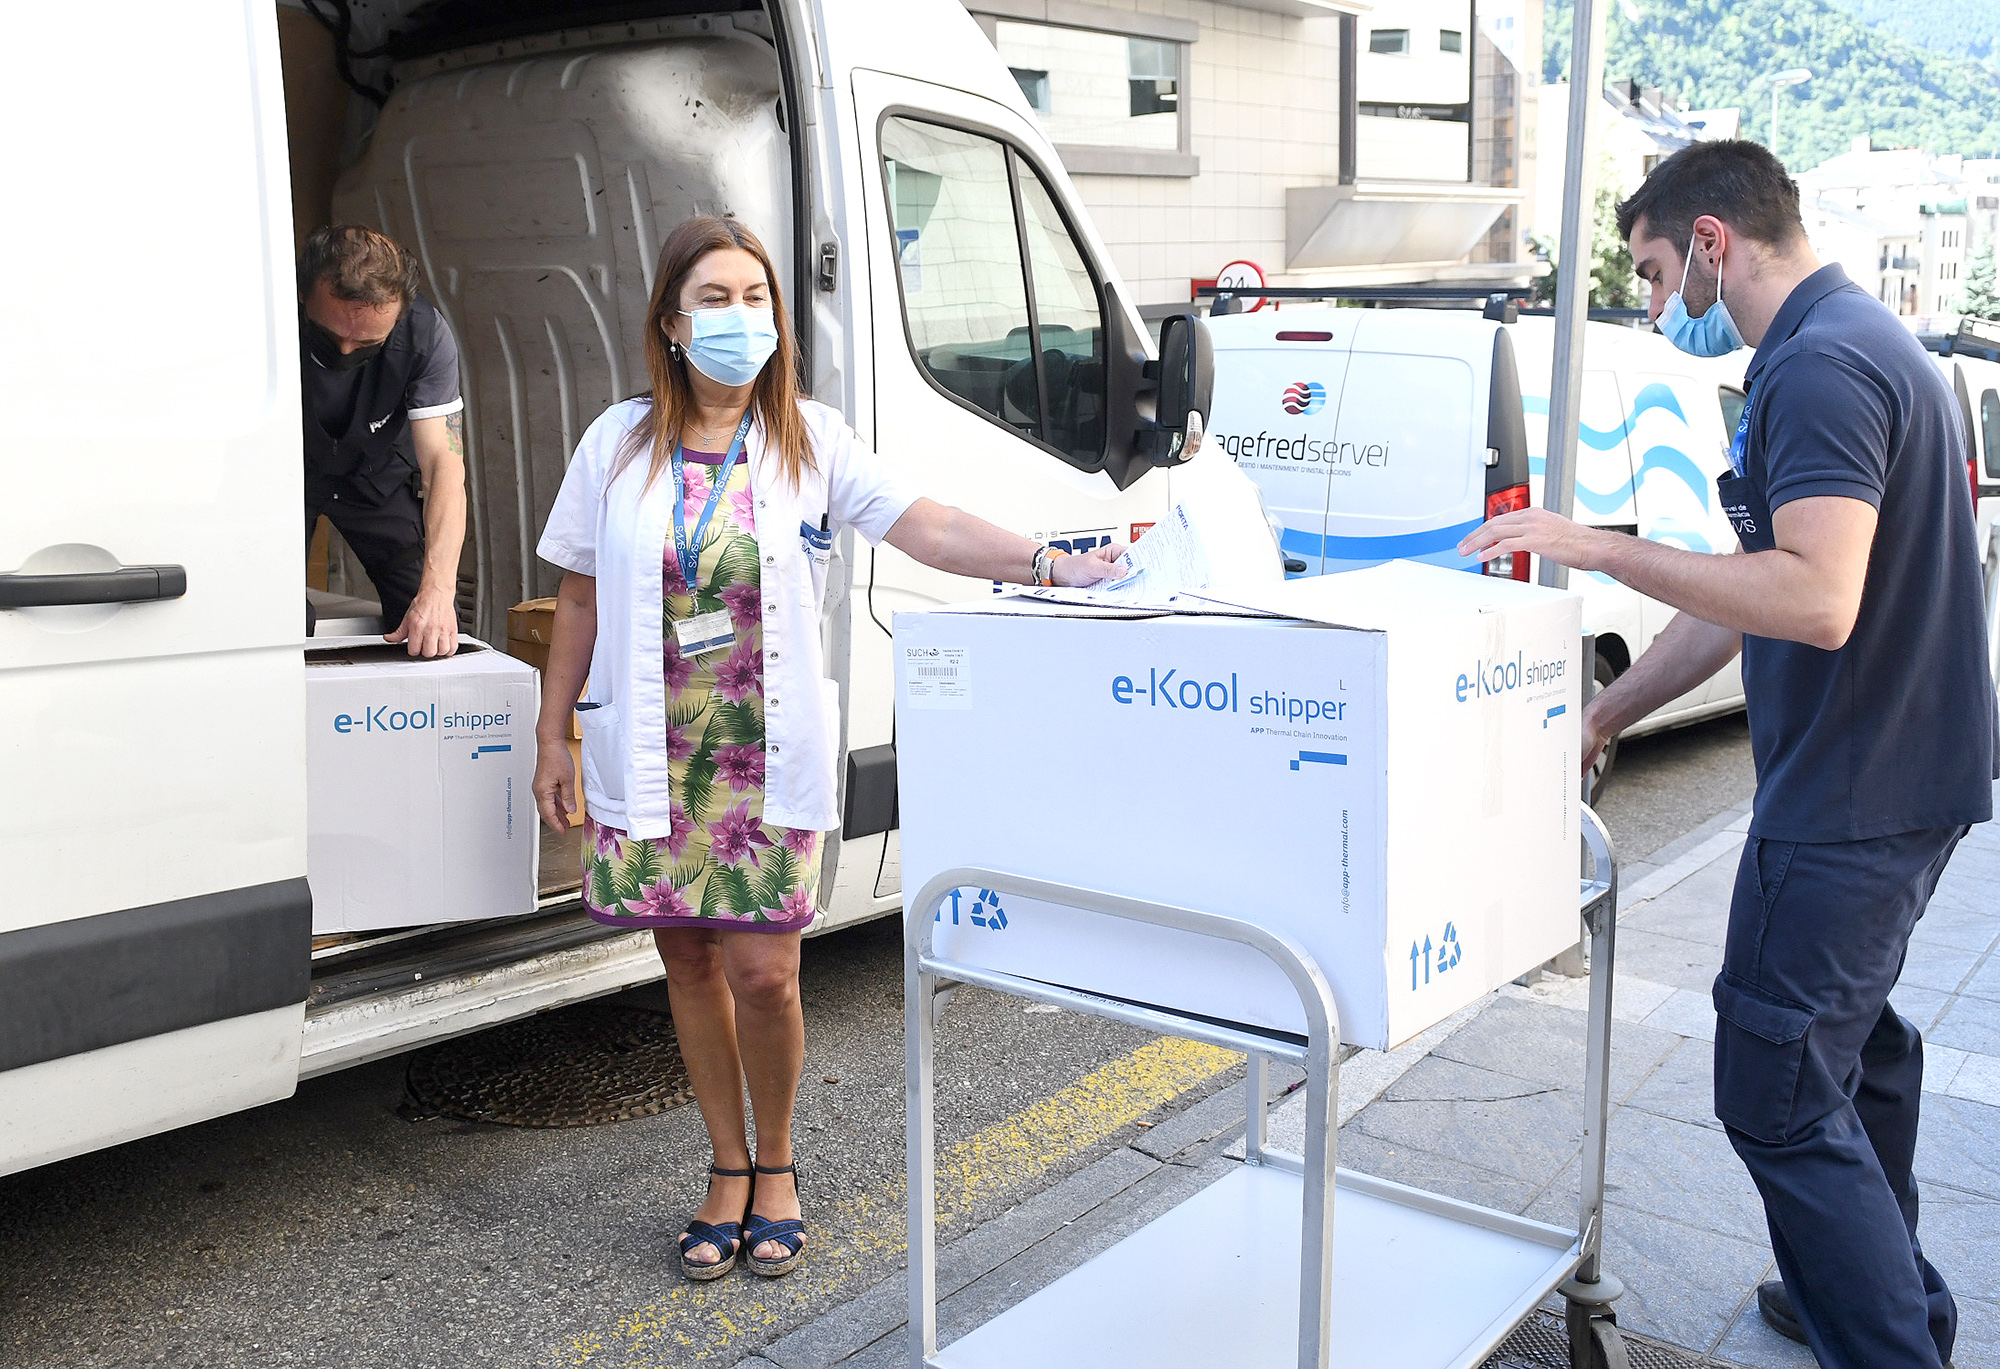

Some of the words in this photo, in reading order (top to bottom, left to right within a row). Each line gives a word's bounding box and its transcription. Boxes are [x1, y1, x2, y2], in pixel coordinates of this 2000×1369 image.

[906, 648, 929, 657] SUCH
[1111, 667, 1238, 713] e-Kool
[1249, 690, 1347, 724] shipper
[1456, 650, 1522, 703] e-Kool
[1526, 659, 1567, 687] shipper
[334, 703, 435, 734] e-Kool
[443, 711, 512, 731] shipper
[1265, 727, 1292, 737] Thermal
[1293, 730, 1312, 738] Chain
[1313, 732, 1348, 742] Innovation
[1341, 809, 1350, 914] info@app-thermal.com
